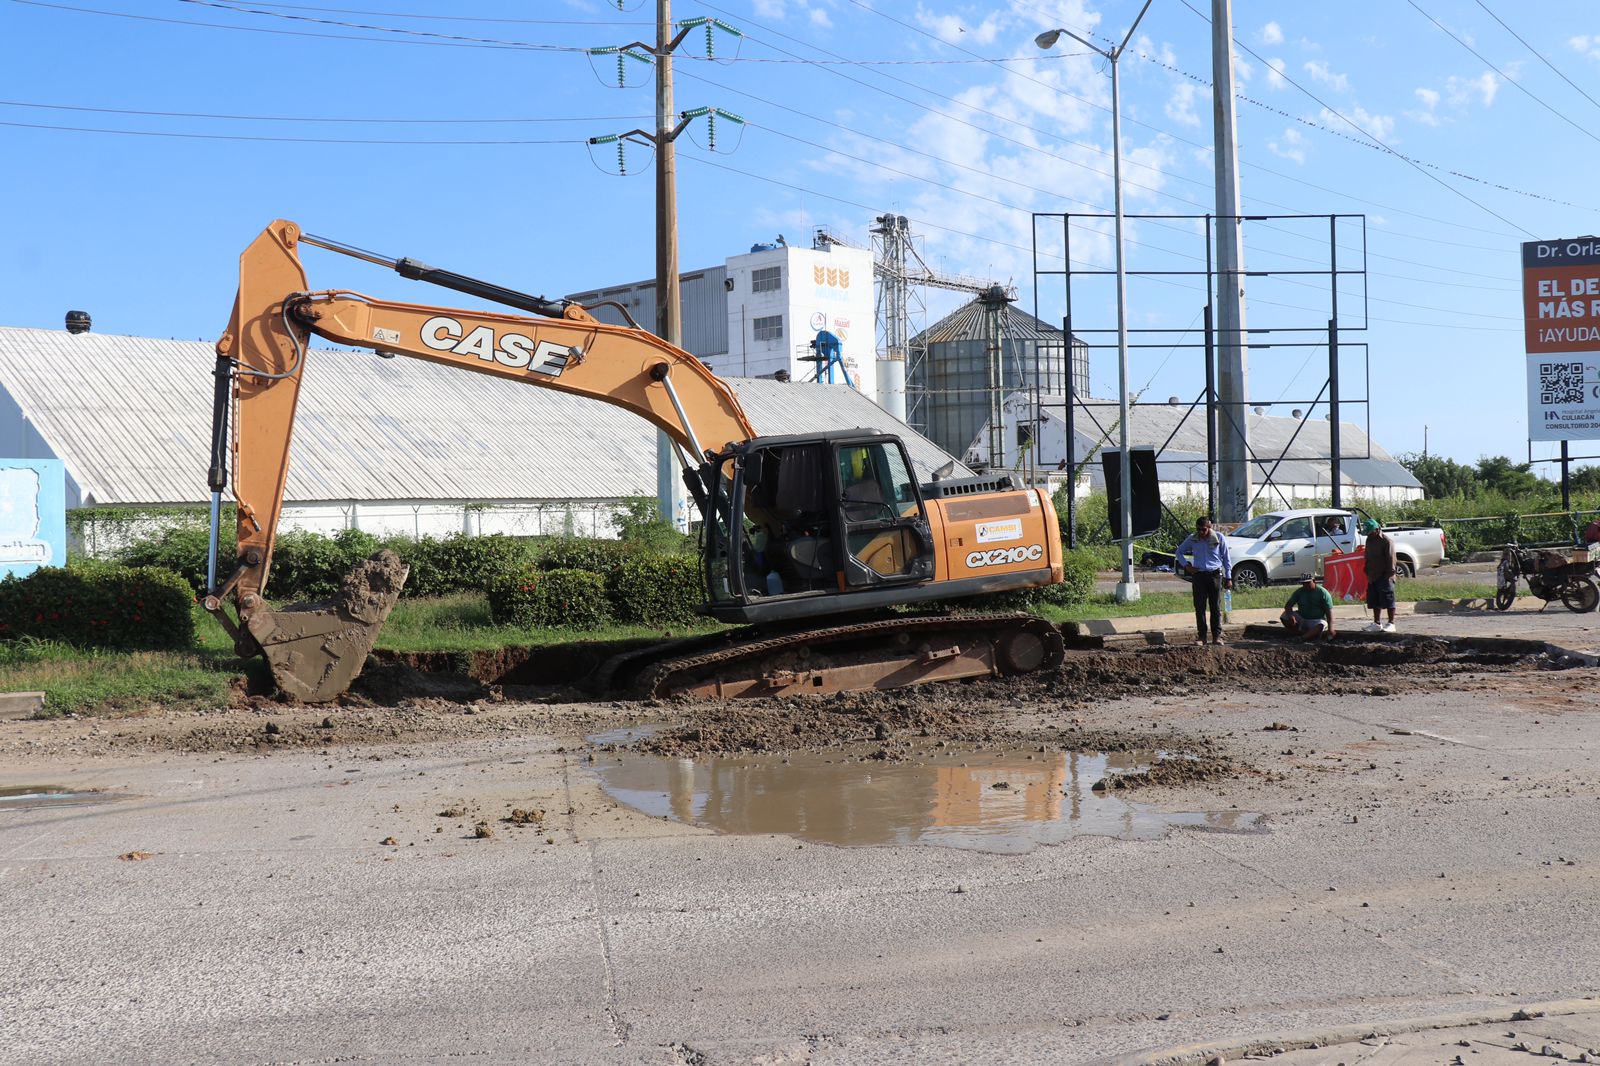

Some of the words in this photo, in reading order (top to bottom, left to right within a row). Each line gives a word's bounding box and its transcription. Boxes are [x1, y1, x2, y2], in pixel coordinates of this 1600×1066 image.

[1537, 244, 1562, 258] Dr.
[1538, 280, 1565, 297] EL
[1571, 278, 1600, 296] DE
[1538, 298, 1585, 319] MÁS
[420, 316, 571, 378] CASE
[1545, 422, 1589, 430] CONSULTORIO
[965, 544, 1042, 568] CX210C
